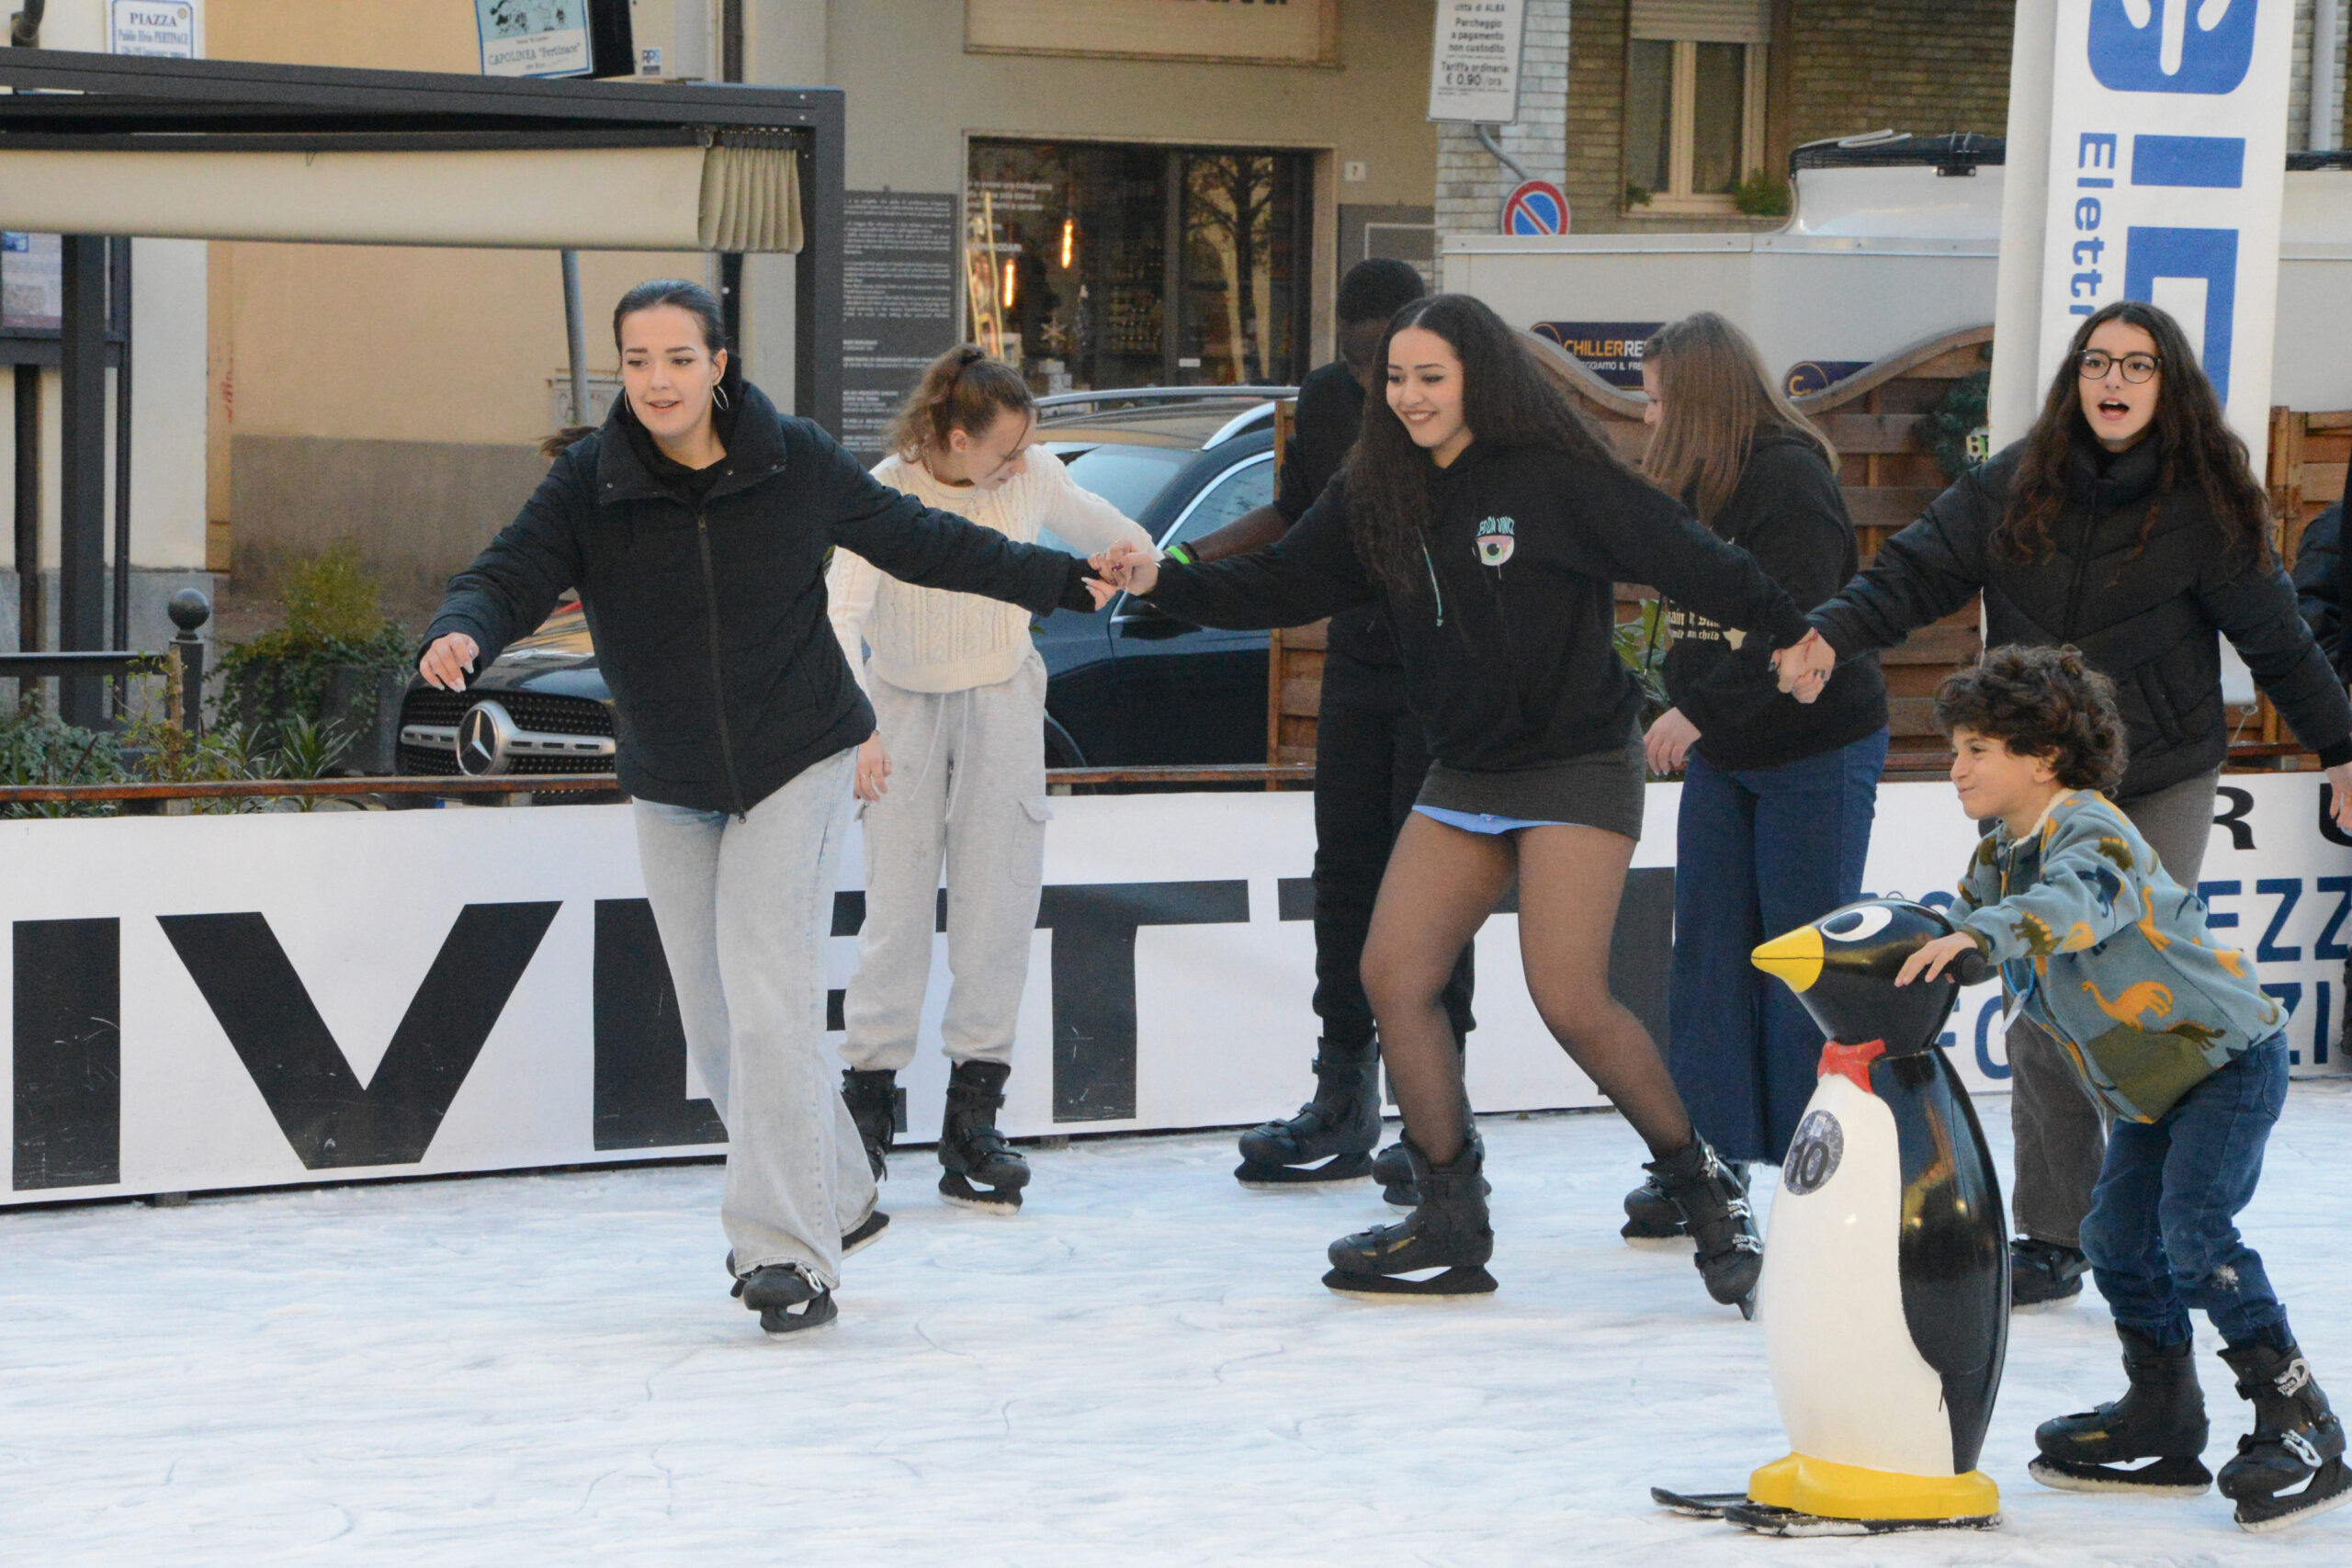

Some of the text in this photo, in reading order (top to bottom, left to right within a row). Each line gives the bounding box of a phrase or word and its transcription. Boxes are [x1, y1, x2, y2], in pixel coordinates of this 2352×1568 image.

[130, 12, 177, 27] PIAZZA
[1455, 17, 1503, 29] Parcheggio
[1458, 31, 1505, 41] pagamento
[1465, 43, 1505, 53] custodito
[488, 49, 537, 65] CAPOLINEA
[1442, 61, 1469, 72] Tariffa
[1446, 73, 1453, 85] €
[1790, 1137, 1829, 1190] 10
